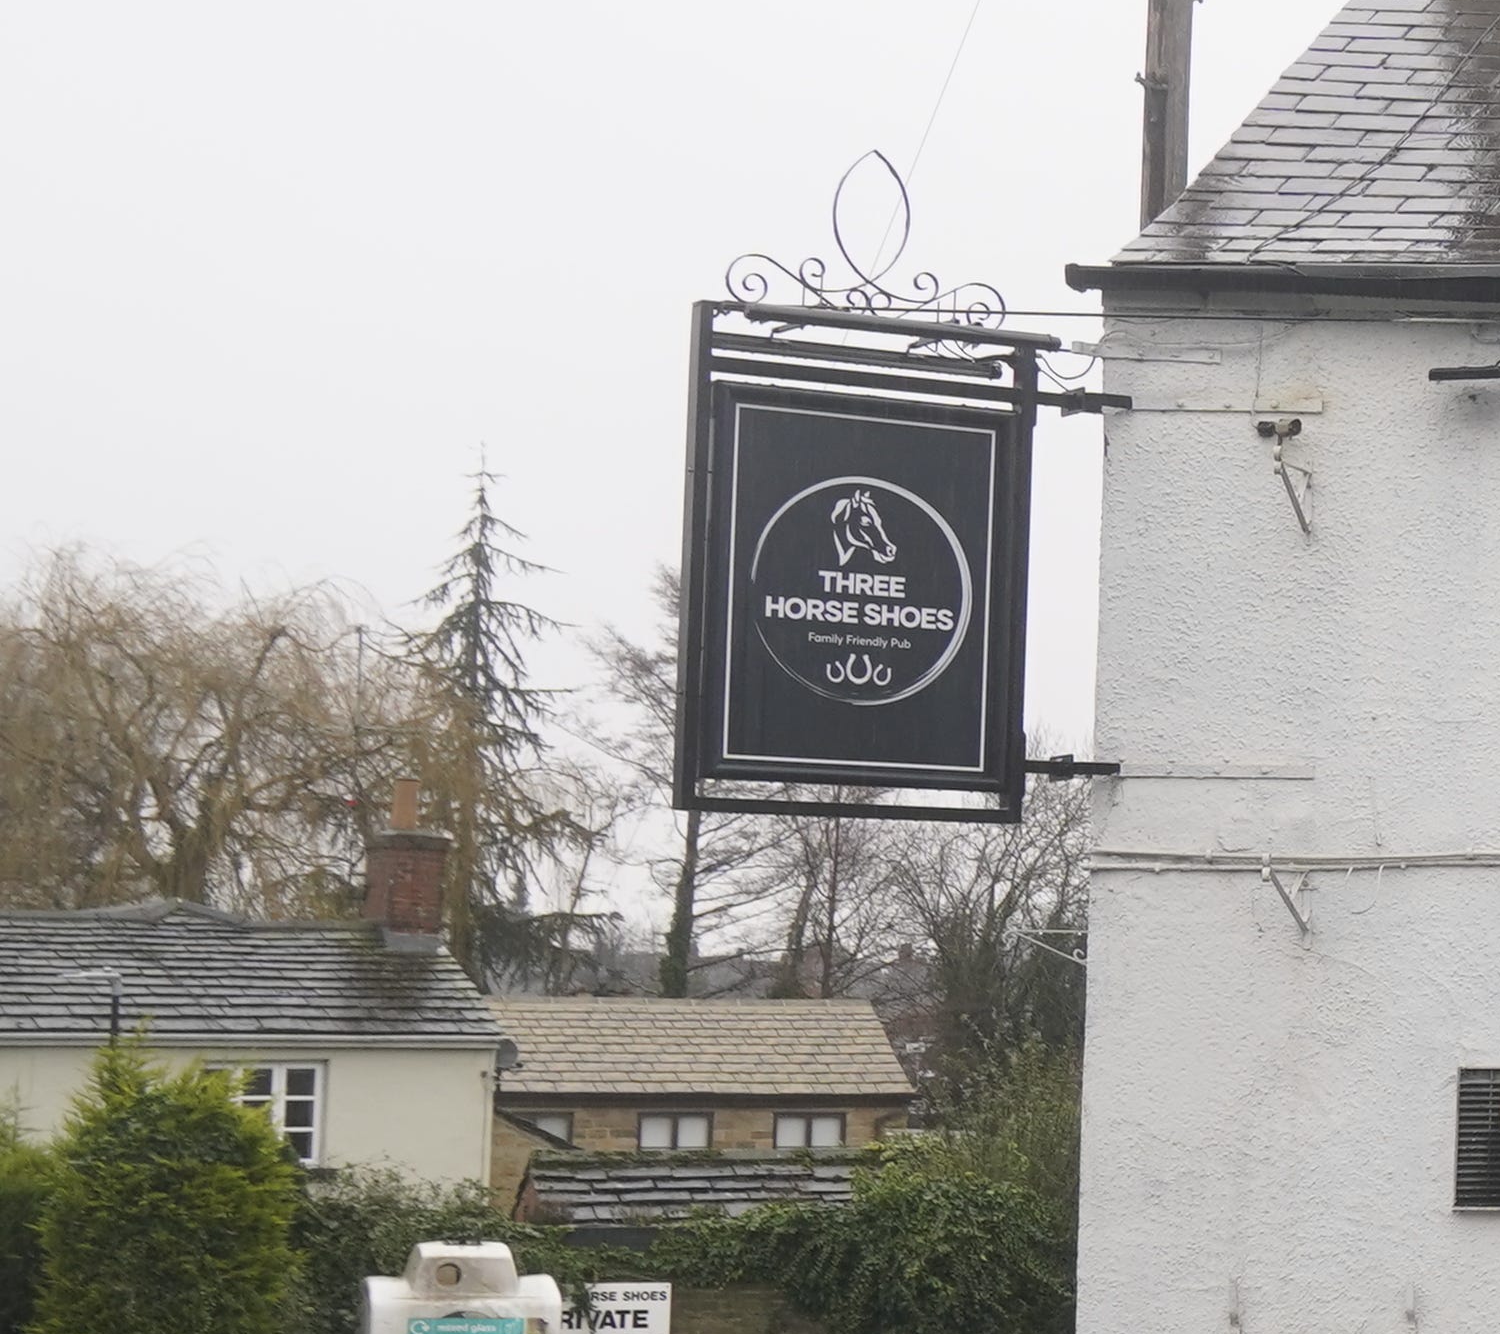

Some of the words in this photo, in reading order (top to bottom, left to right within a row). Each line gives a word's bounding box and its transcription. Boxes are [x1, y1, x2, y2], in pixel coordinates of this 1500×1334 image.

[818, 570, 906, 598] THREE
[765, 595, 859, 624] HORSE
[863, 603, 954, 631] SHOES
[808, 632, 844, 646] Family
[846, 635, 889, 649] Friendly
[891, 638, 911, 649] Pub
[590, 1291, 617, 1301] RSE
[623, 1291, 667, 1301] SHOES
[561, 1310, 649, 1329] RIVATE
